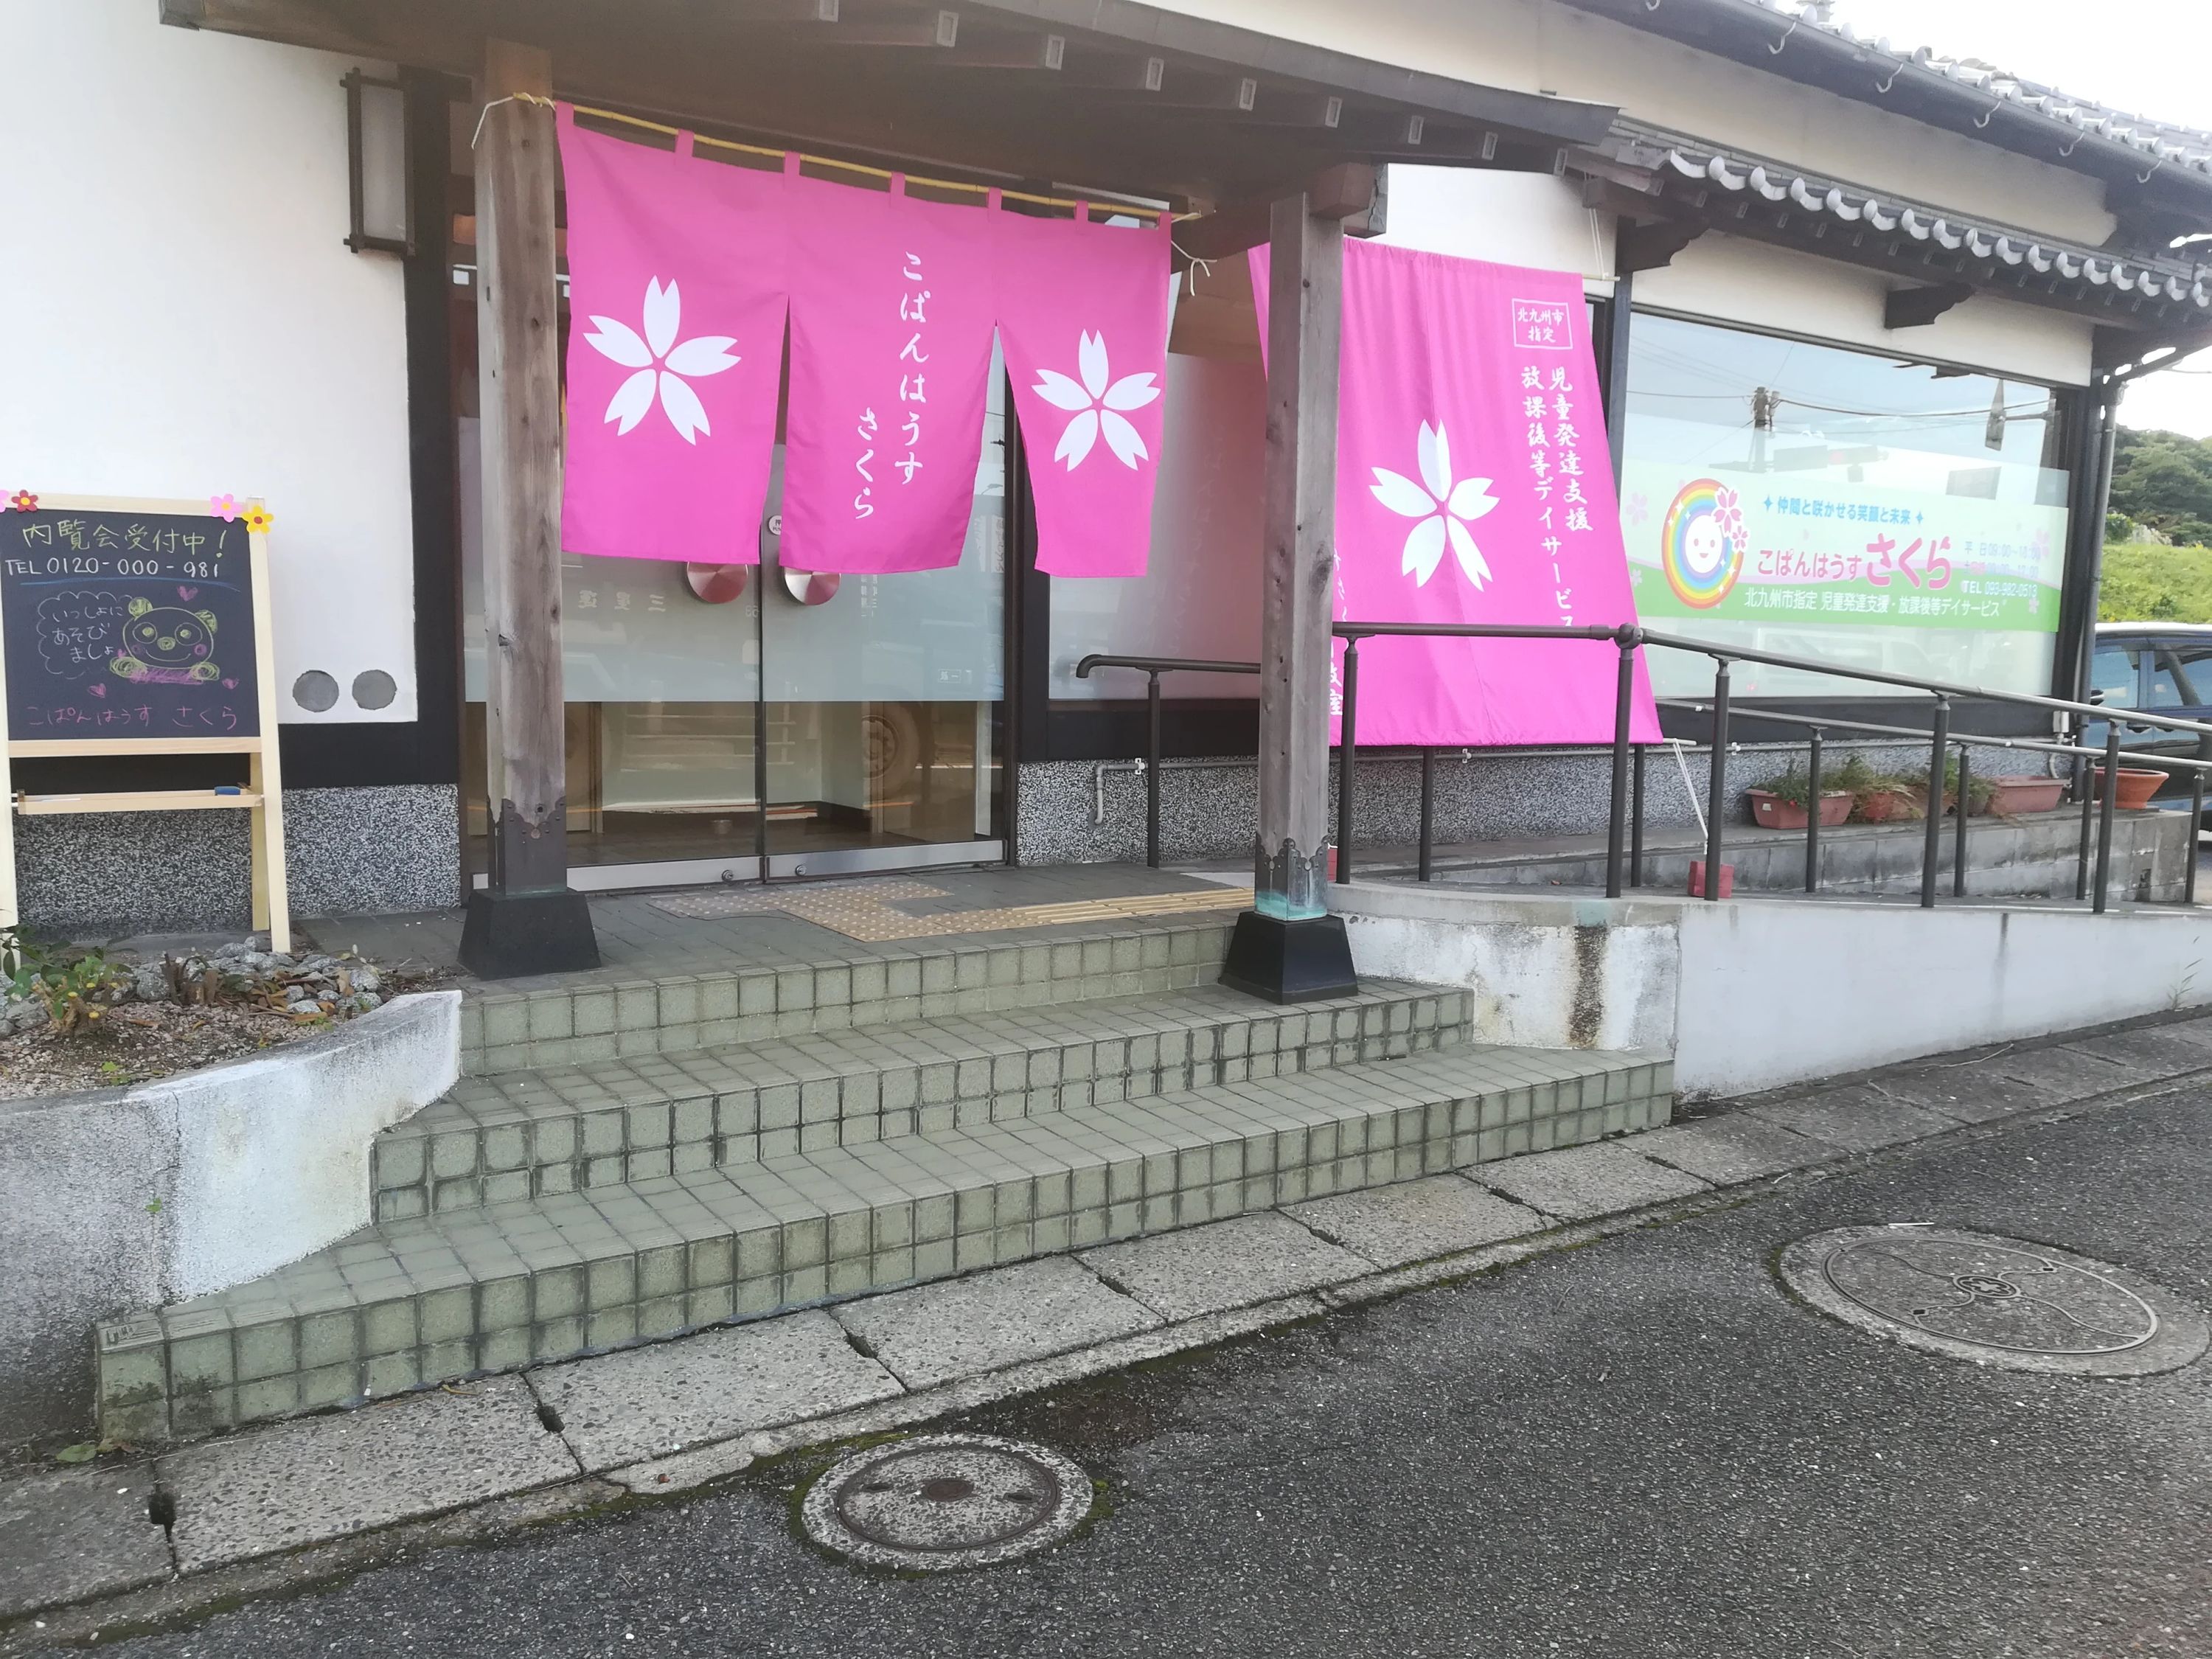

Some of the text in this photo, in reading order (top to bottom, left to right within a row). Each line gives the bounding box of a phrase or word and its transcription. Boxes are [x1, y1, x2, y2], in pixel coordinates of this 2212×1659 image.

[1517, 307, 1564, 326] 北九州市
[1528, 326, 1556, 342] 指定
[894, 251, 931, 485] こぱんはうす
[1549, 366, 1593, 532] 児童発達支援
[853, 407, 878, 520] さくら
[5, 559, 42, 576] TEL
[1745, 587, 1818, 610] 北九州市指定
[1962, 580, 1982, 594] TEL
[52, 605, 123, 622] いっしょに
[52, 622, 111, 646] あそび
[172, 706, 237, 730] さくら
